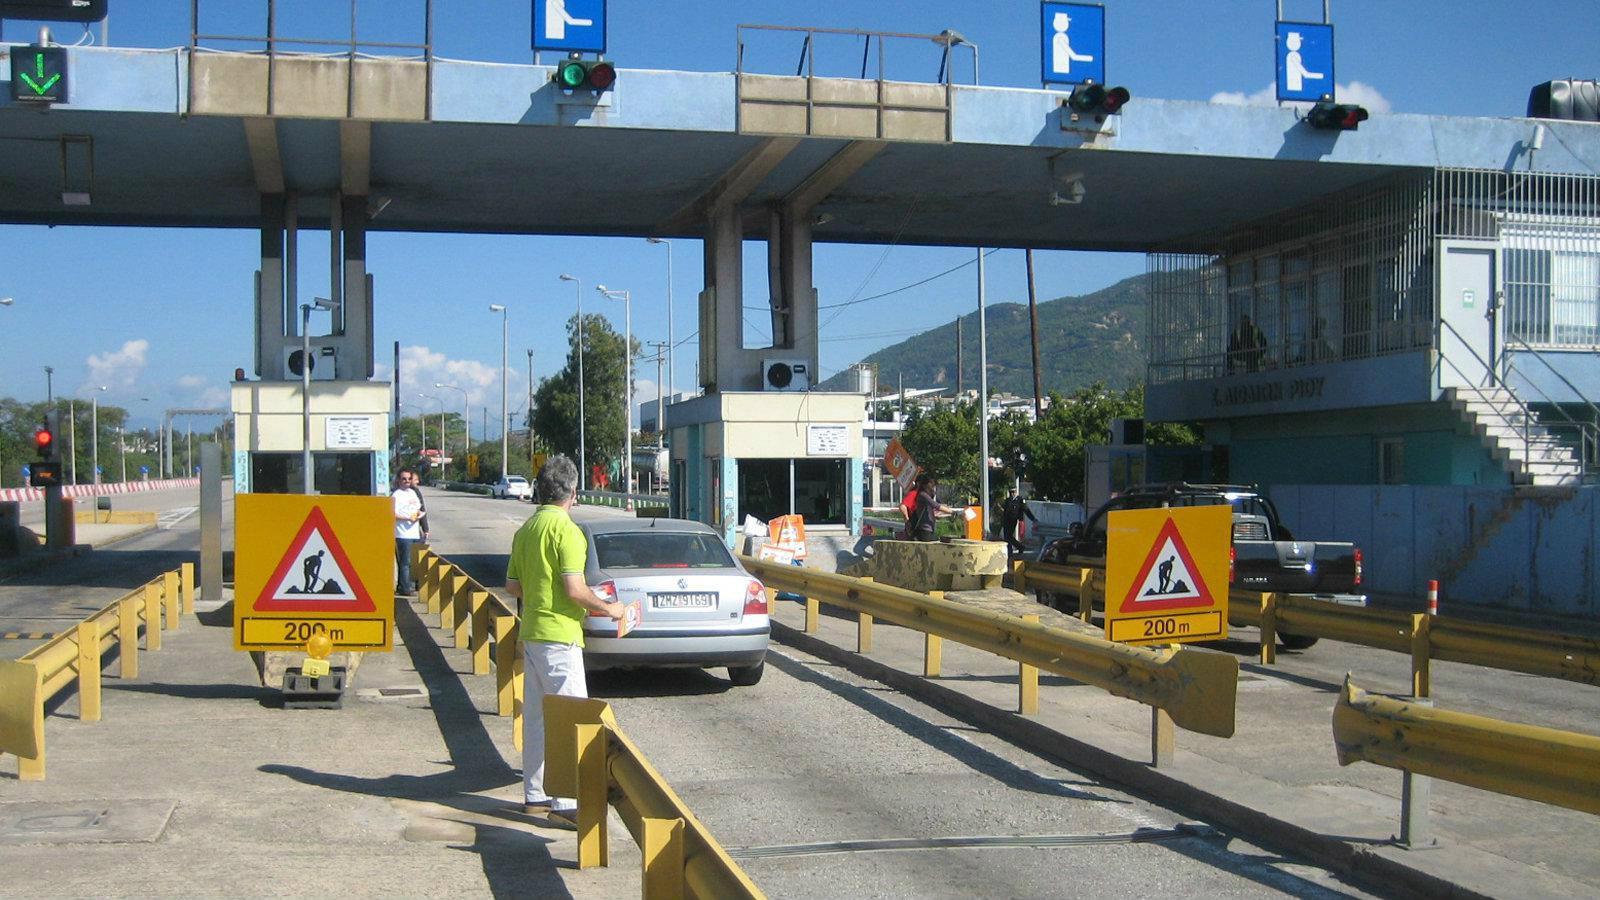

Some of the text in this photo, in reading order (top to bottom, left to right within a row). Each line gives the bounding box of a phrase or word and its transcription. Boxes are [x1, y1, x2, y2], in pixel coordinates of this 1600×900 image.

[330, 628, 344, 640] m
[1143, 618, 1190, 637] 200 m
